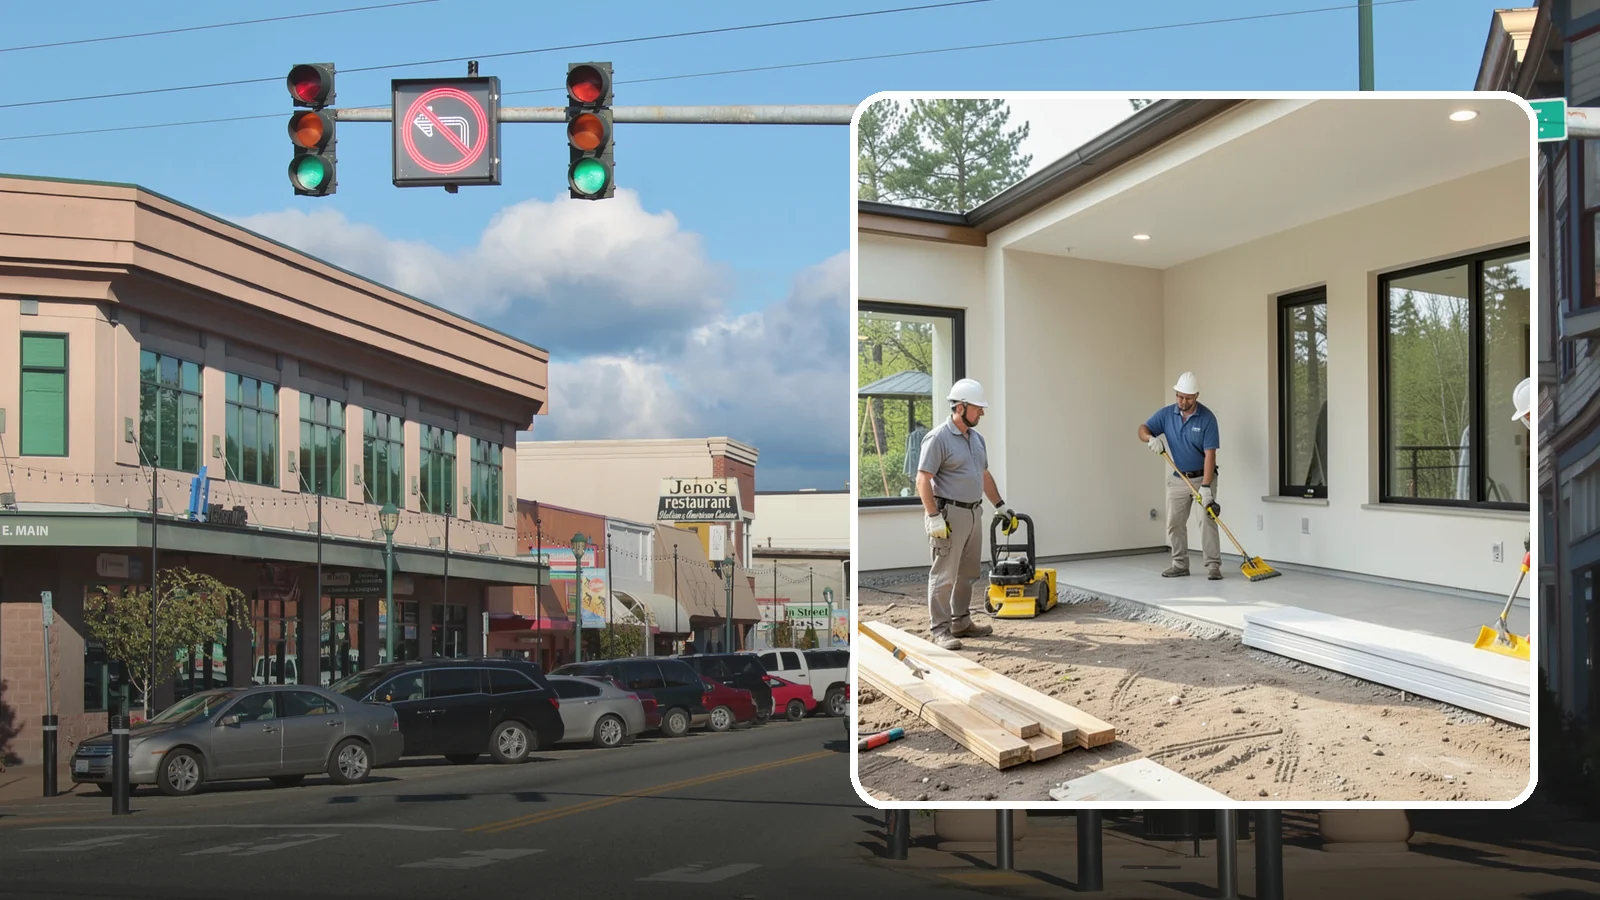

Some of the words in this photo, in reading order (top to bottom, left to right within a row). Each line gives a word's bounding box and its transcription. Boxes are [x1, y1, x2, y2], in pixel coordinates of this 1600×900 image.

[669, 480, 727, 495] Jeno's
[665, 496, 731, 509] restaurant
[659, 509, 681, 520] Italian
[686, 509, 714, 520] American
[715, 509, 737, 520] Cuisine
[2, 525, 13, 536] E.
[16, 525, 49, 537] MAIN
[797, 607, 829, 617] Street
